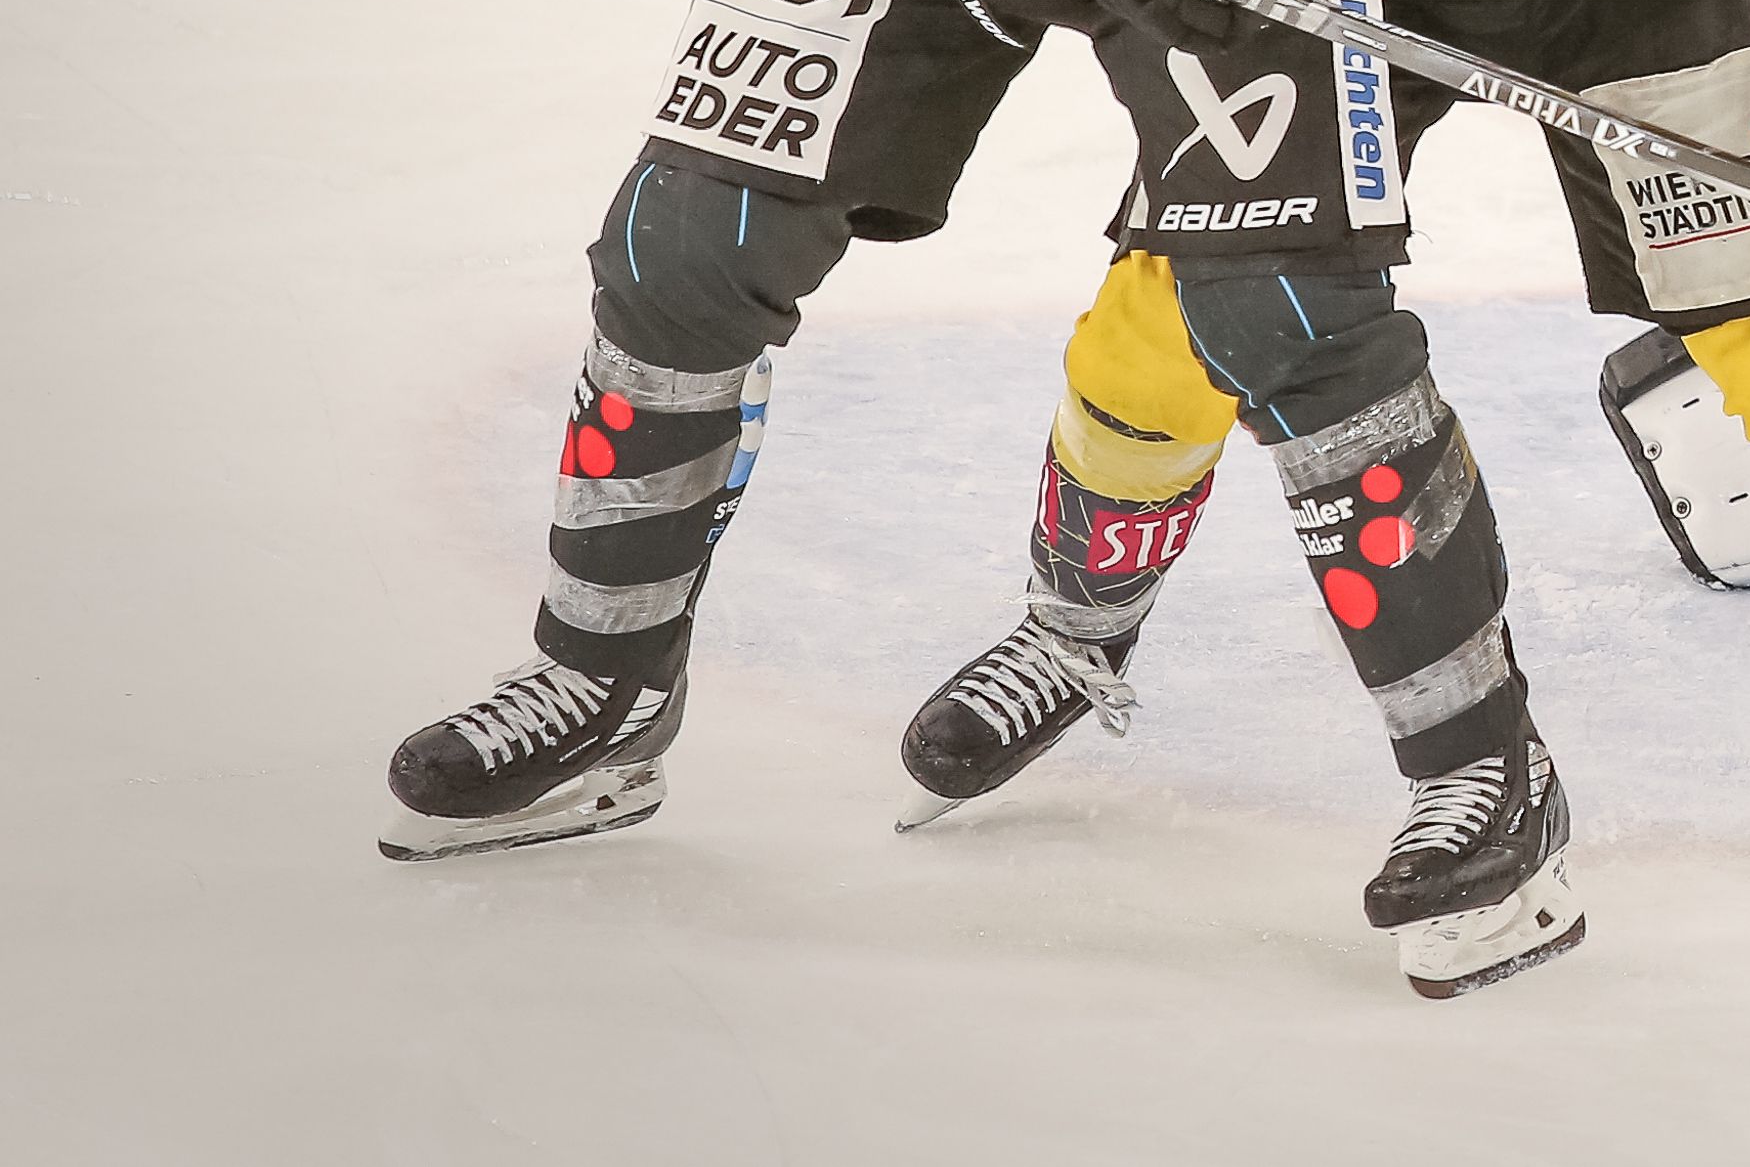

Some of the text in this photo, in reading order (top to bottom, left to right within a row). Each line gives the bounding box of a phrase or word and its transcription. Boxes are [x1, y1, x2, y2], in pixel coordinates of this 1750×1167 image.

[677, 22, 840, 103] AUTO
[655, 75, 822, 161] EDER
[1458, 70, 1582, 136] ALPHA
[1157, 195, 1320, 234] BAUER
[1097, 501, 1203, 570] STE
